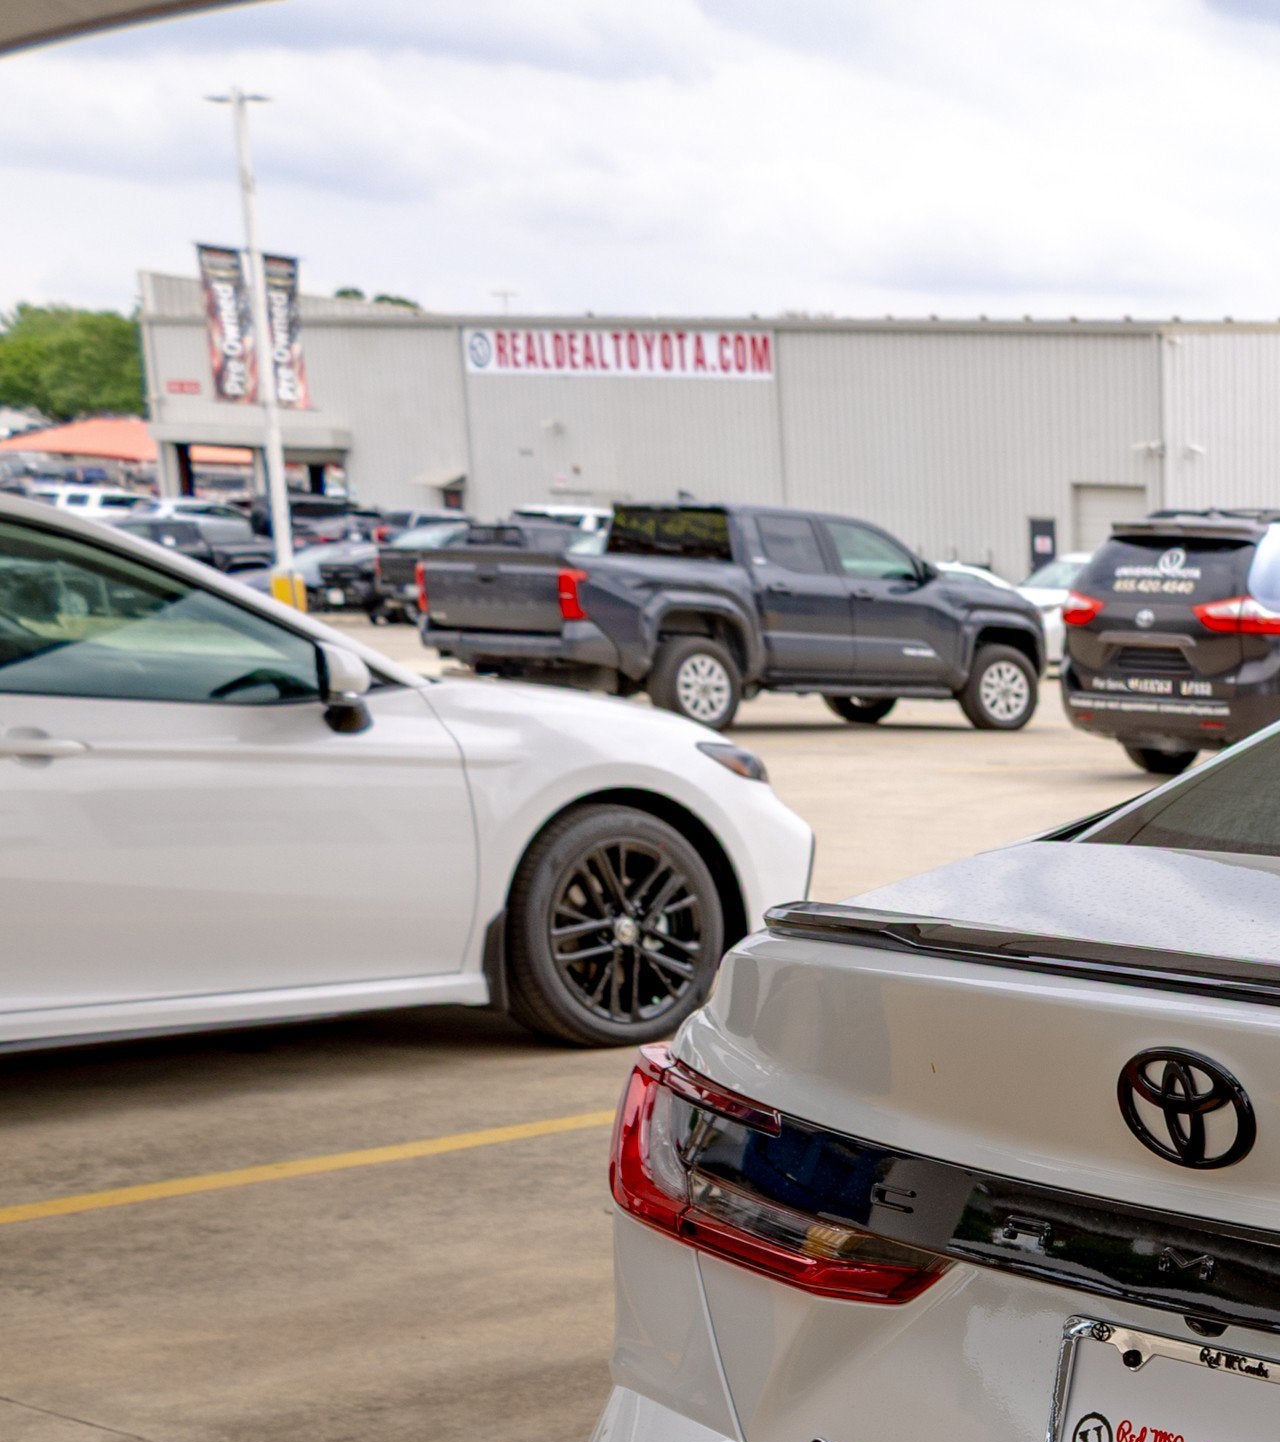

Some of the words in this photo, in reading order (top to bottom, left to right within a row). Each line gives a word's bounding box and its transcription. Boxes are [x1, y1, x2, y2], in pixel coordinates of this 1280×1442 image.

[211, 280, 243, 359] Owned
[266, 290, 291, 363] Owned
[495, 330, 773, 374] REALDEALTOYOTA.COM
[1200, 1346, 1221, 1369] Red
